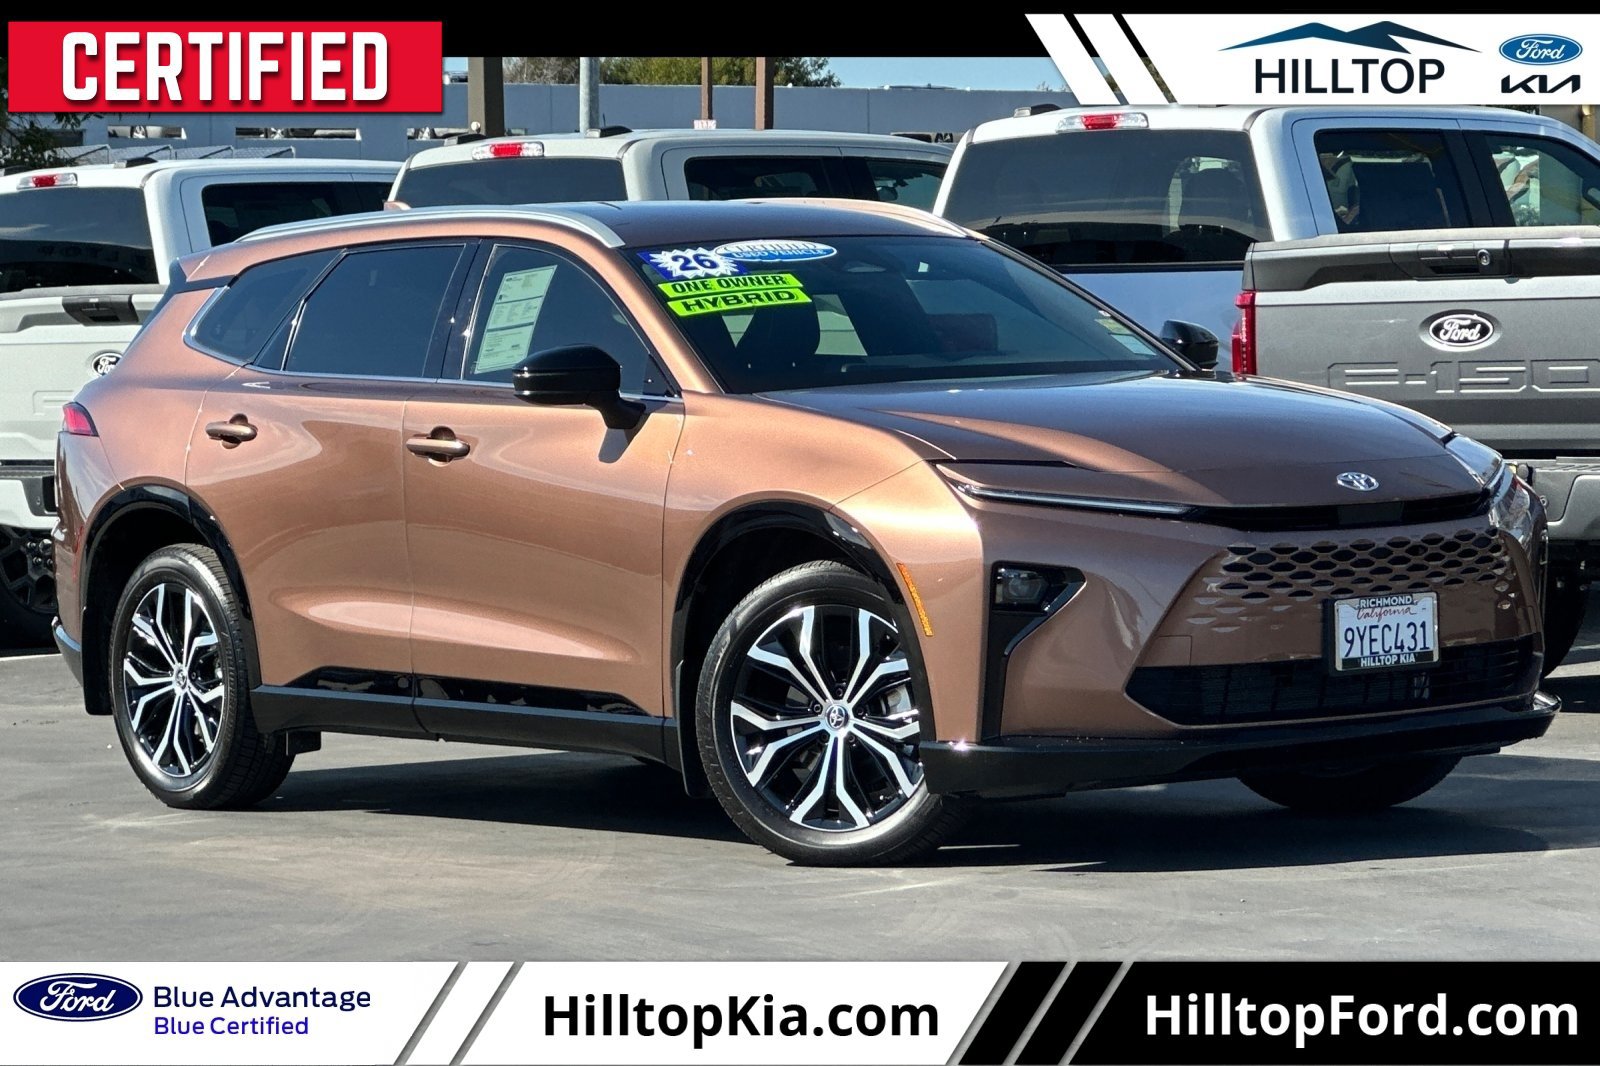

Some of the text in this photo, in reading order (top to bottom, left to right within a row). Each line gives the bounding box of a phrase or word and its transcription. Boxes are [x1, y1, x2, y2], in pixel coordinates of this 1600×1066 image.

[671, 253, 720, 272] 26
[671, 275, 788, 294] ONE OWNER
[683, 290, 796, 312] HYBRID
[1439, 318, 1482, 342] Ford
[1360, 595, 1412, 608] RICHMOND
[1356, 607, 1417, 622] California
[1344, 620, 1430, 658] 9YEC431
[1360, 653, 1416, 667] HILLTOP KIA
